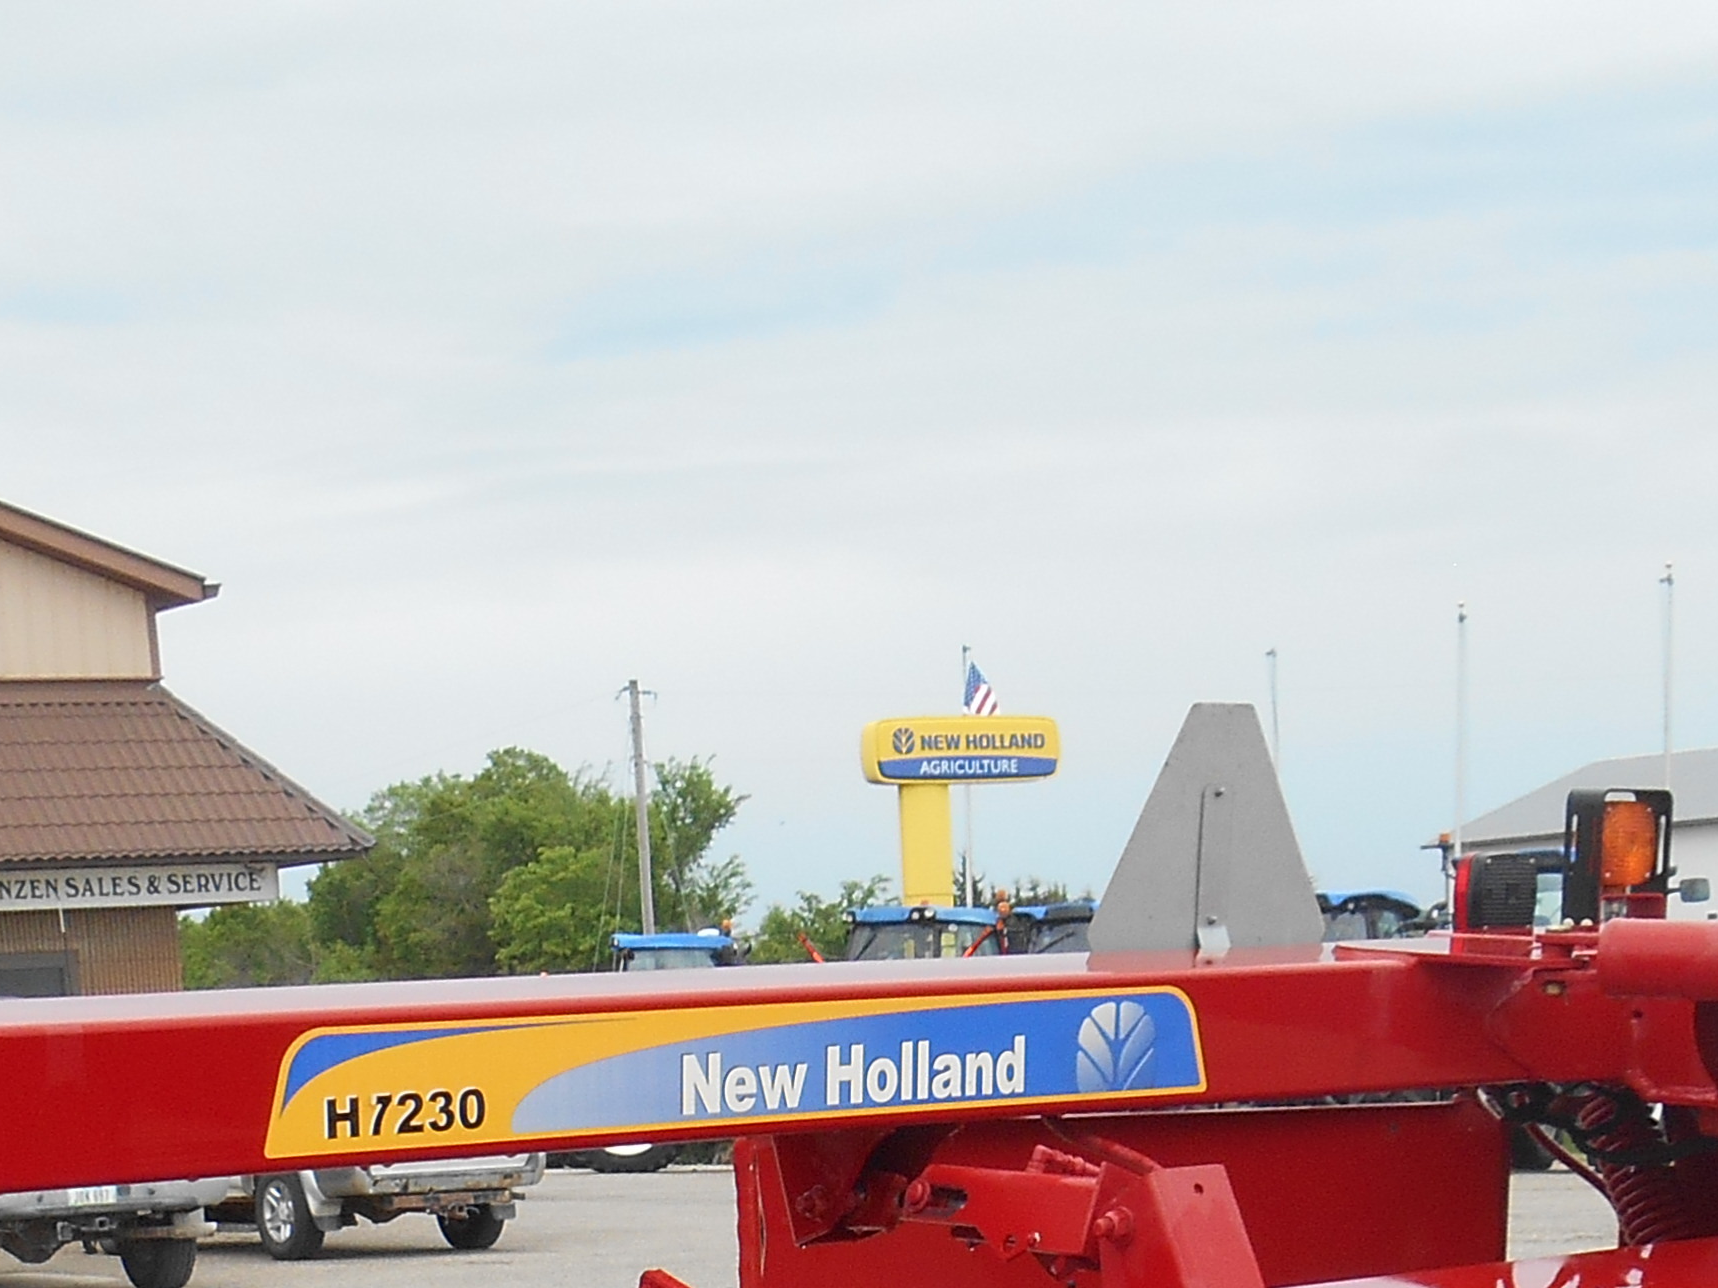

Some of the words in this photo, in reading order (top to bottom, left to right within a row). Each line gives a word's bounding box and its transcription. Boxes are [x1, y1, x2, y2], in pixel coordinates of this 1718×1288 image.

[920, 734, 960, 750] NEW
[966, 733, 1045, 750] HOLLAND
[920, 758, 1018, 775] AGRICULTURE
[65, 875, 141, 898] SALES
[147, 875, 162, 895] &
[166, 870, 262, 895] SERVICE
[682, 1052, 807, 1115] New
[826, 1034, 1026, 1106] Holland
